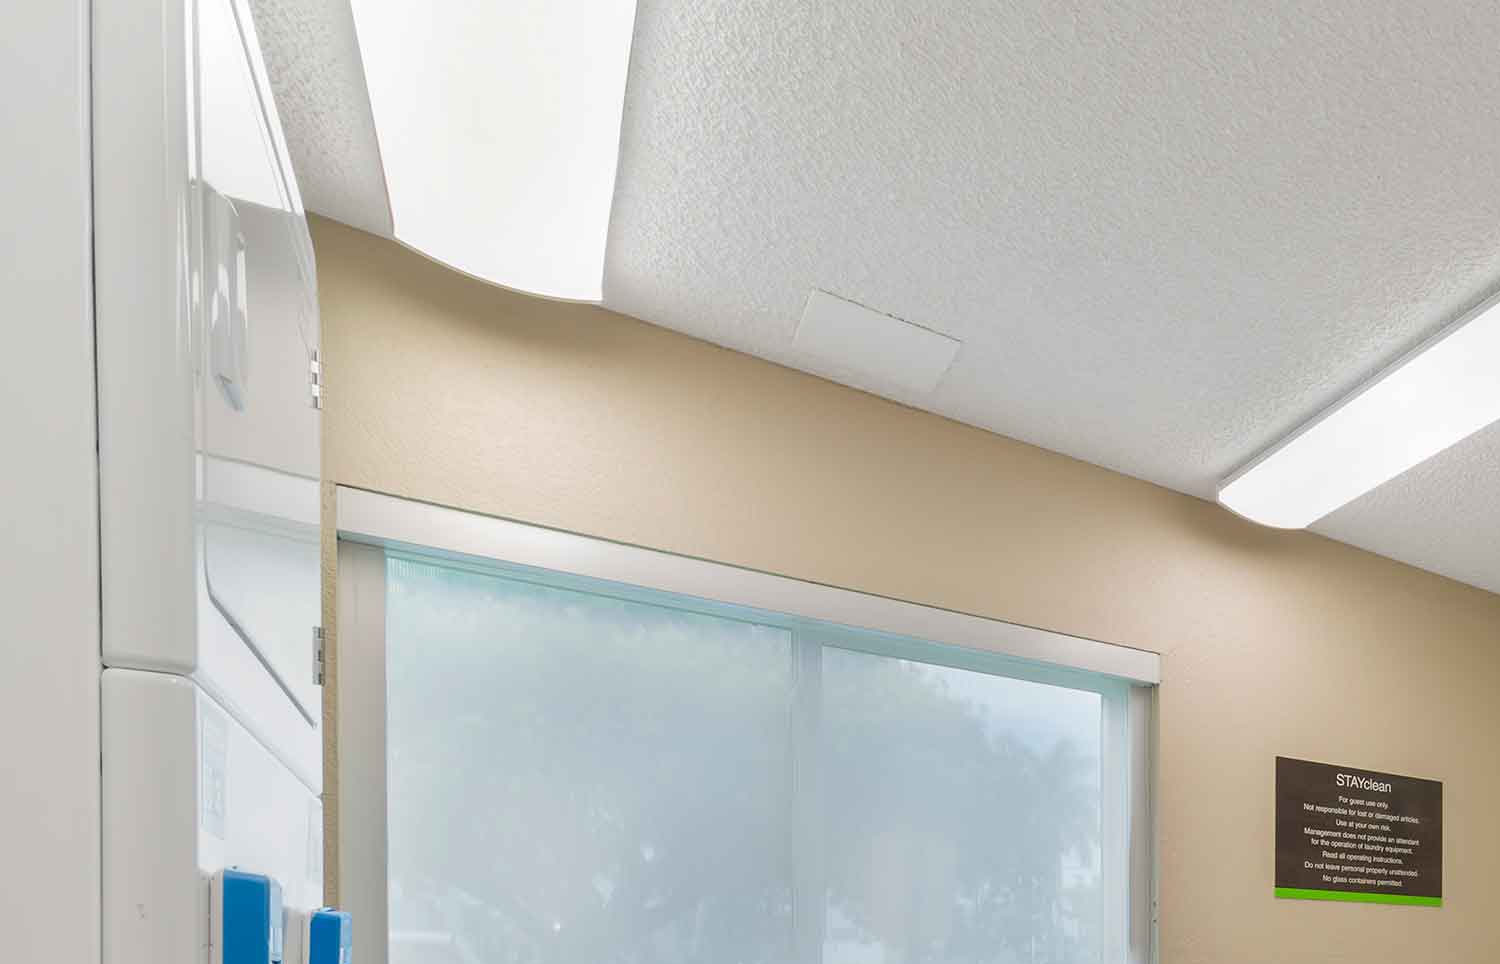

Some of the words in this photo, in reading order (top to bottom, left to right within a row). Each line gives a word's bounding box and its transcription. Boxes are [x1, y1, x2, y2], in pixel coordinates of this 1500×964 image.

[1336, 773, 1391, 792] STAYclean
[1338, 795, 1348, 803] For
[1349, 798, 1365, 806] guest
[1303, 803, 1314, 811] Not
[1315, 804, 1348, 815] responsible
[1348, 808, 1356, 816] for
[1375, 811, 1400, 822] damaged
[1400, 816, 1420, 824] articles.
[1336, 819, 1347, 827] Use
[1348, 820, 1354, 828] at
[1355, 821, 1367, 830] your
[1368, 823, 1379, 831] own
[1303, 827, 1341, 838] Management
[1342, 831, 1356, 840] does
[1357, 833, 1366, 841] not
[1367, 834, 1387, 843] provide
[1311, 837, 1319, 845] for
[1320, 838, 1330, 846] the
[1330, 840, 1356, 849] operation
[1357, 841, 1364, 849] of
[1364, 842, 1384, 852] laundry
[1322, 850, 1338, 859] Read
[1346, 853, 1372, 863] operating
[1304, 861, 1313, 869] Do
[1314, 862, 1324, 870] not
[1325, 863, 1340, 871] leave
[1341, 865, 1365, 873] personal
[1322, 874, 1331, 882] No
